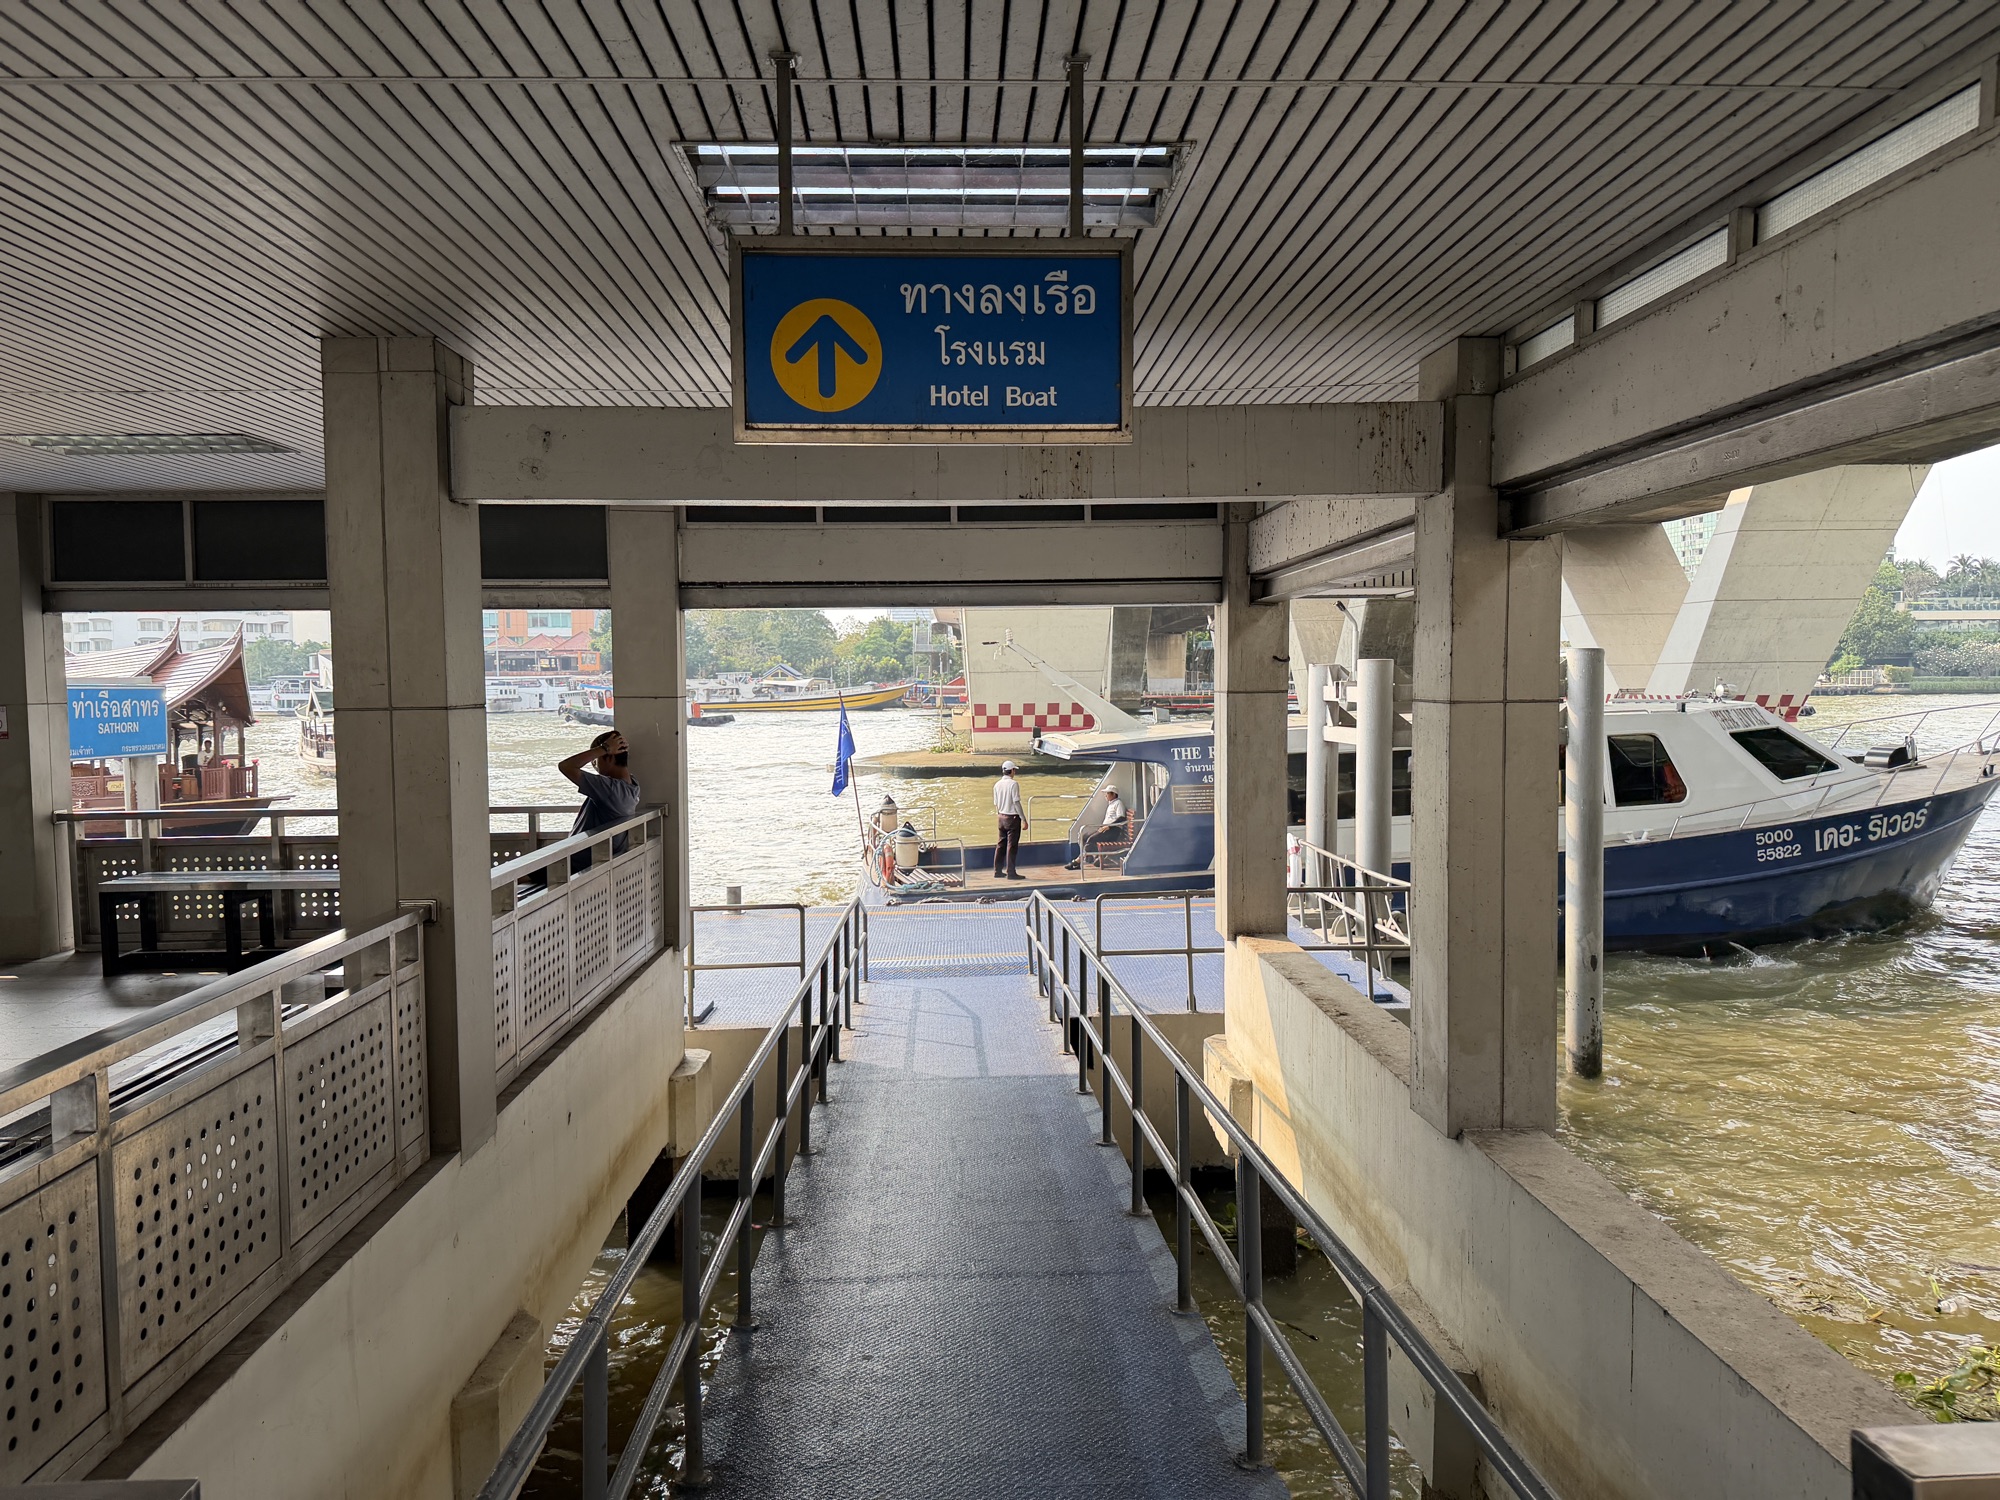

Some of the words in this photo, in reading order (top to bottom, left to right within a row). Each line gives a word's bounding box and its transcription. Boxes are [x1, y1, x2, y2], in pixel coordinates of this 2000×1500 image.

[900, 270, 1096, 315] ทางลงเรือ
[934, 325, 1045, 366] โรงแรม
[930, 385, 989, 407] Hotel
[1006, 386, 1057, 407] Boat
[72, 690, 160, 719] ท่าเรือสาทร
[98, 722, 139, 735] SATHORN
[1171, 747, 1202, 760] THE
[1755, 828, 1794, 846] 5000
[1815, 824, 1862, 853] เดอะ
[1868, 800, 1932, 841] ริเวอร์
[1756, 843, 1802, 862] 55822
